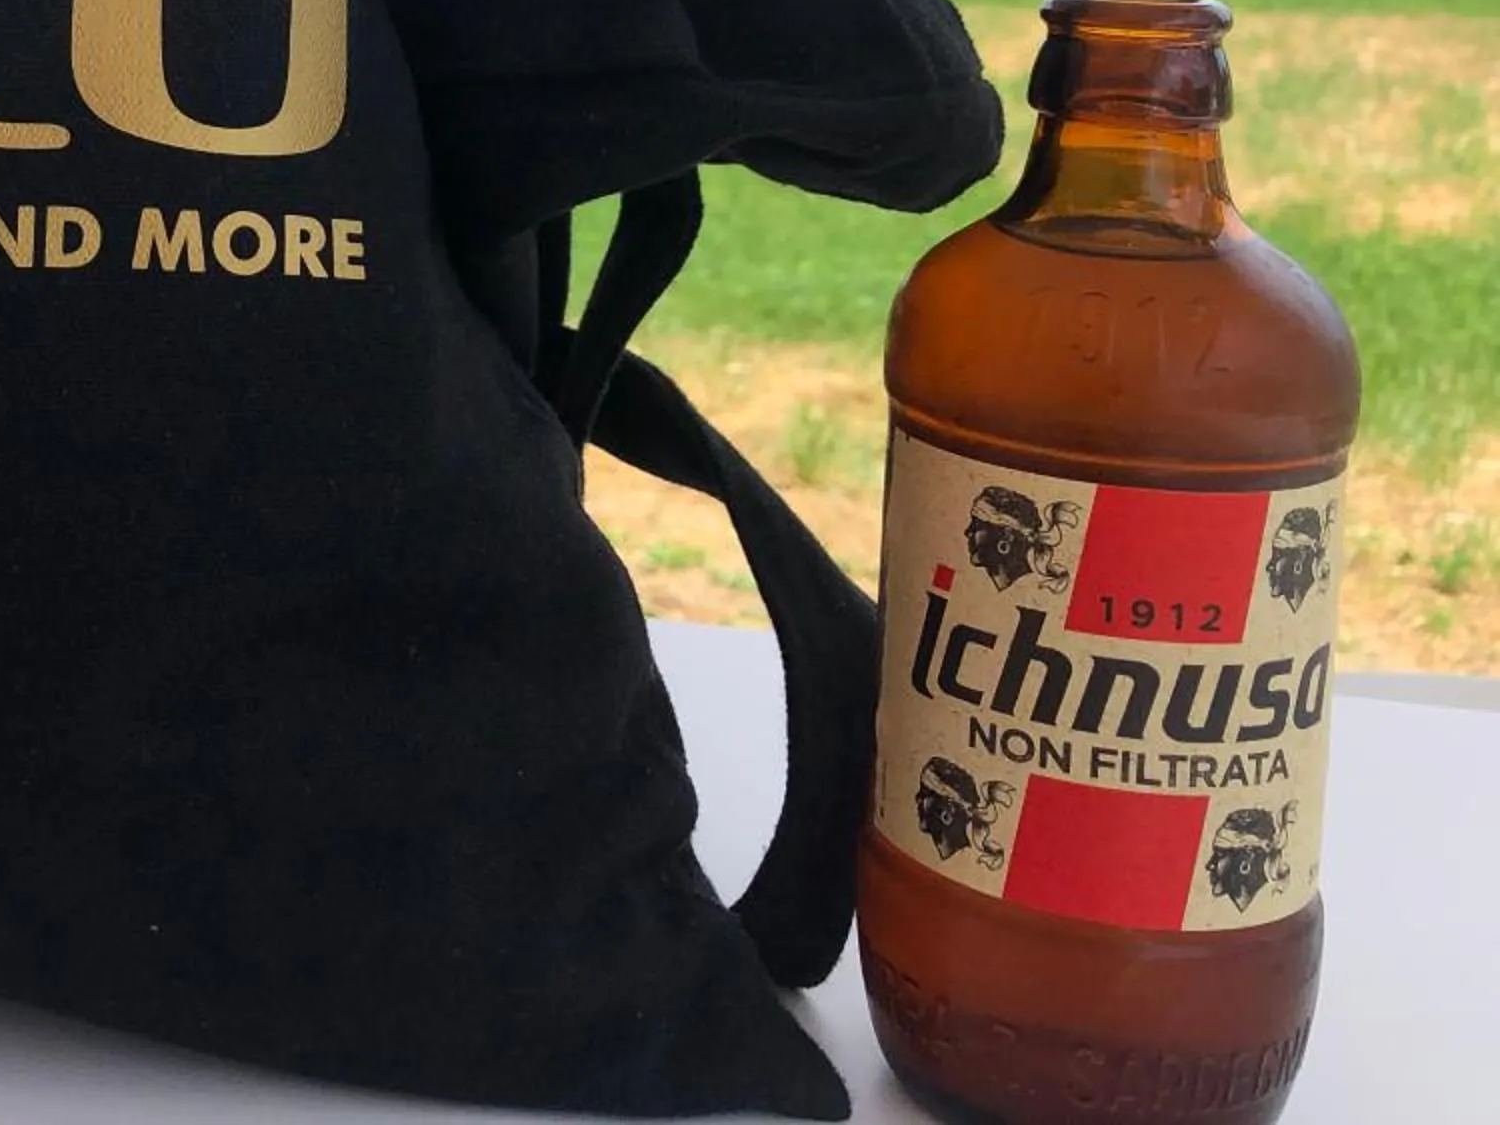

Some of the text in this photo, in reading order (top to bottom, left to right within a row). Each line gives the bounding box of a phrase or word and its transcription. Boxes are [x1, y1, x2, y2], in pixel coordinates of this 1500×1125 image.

[132, 206, 367, 280] MORE
[1101, 597, 1223, 632] 1912
[911, 563, 1330, 744] ichnusa
[967, 716, 1289, 788] NON FILTRATA
